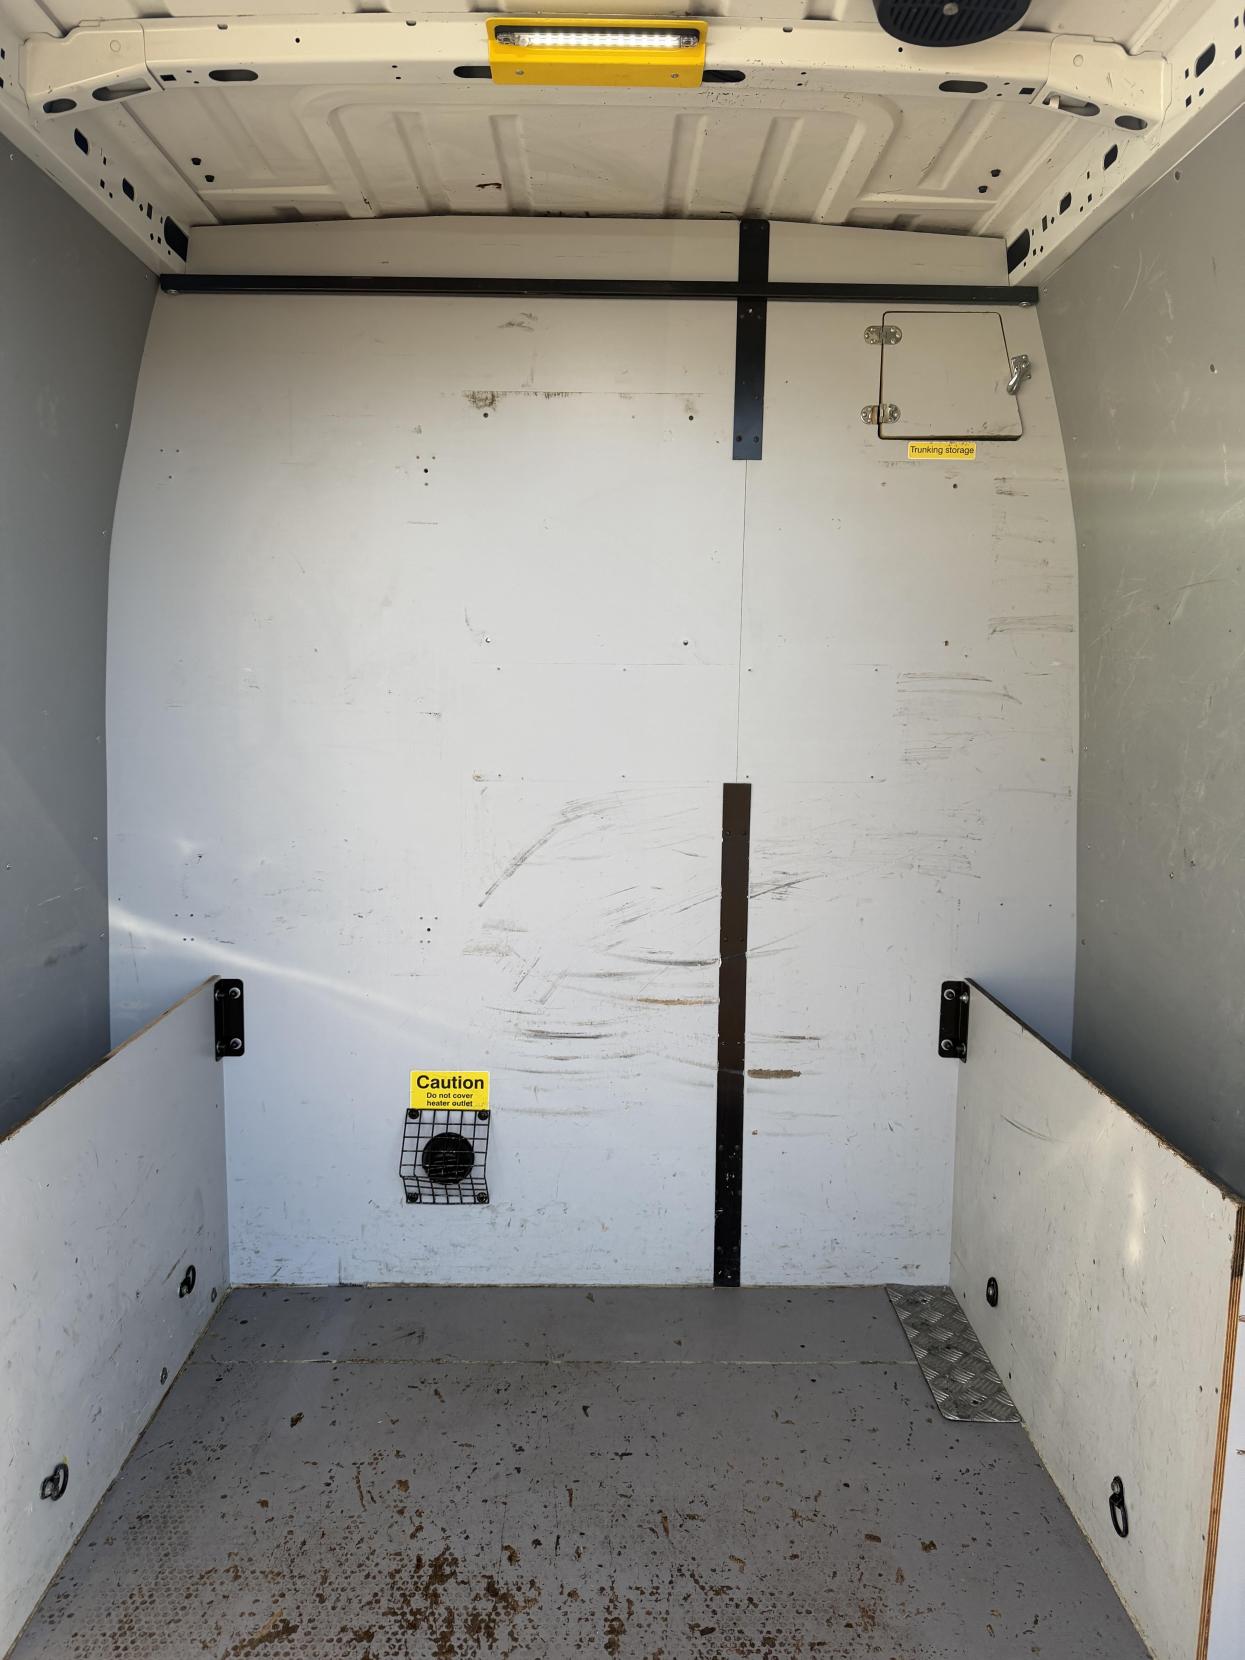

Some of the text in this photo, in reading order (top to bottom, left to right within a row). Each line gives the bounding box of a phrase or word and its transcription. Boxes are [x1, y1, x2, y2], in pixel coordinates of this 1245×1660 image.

[910, 446, 975, 455] Trunking storage
[416, 1074, 484, 1089] Caution
